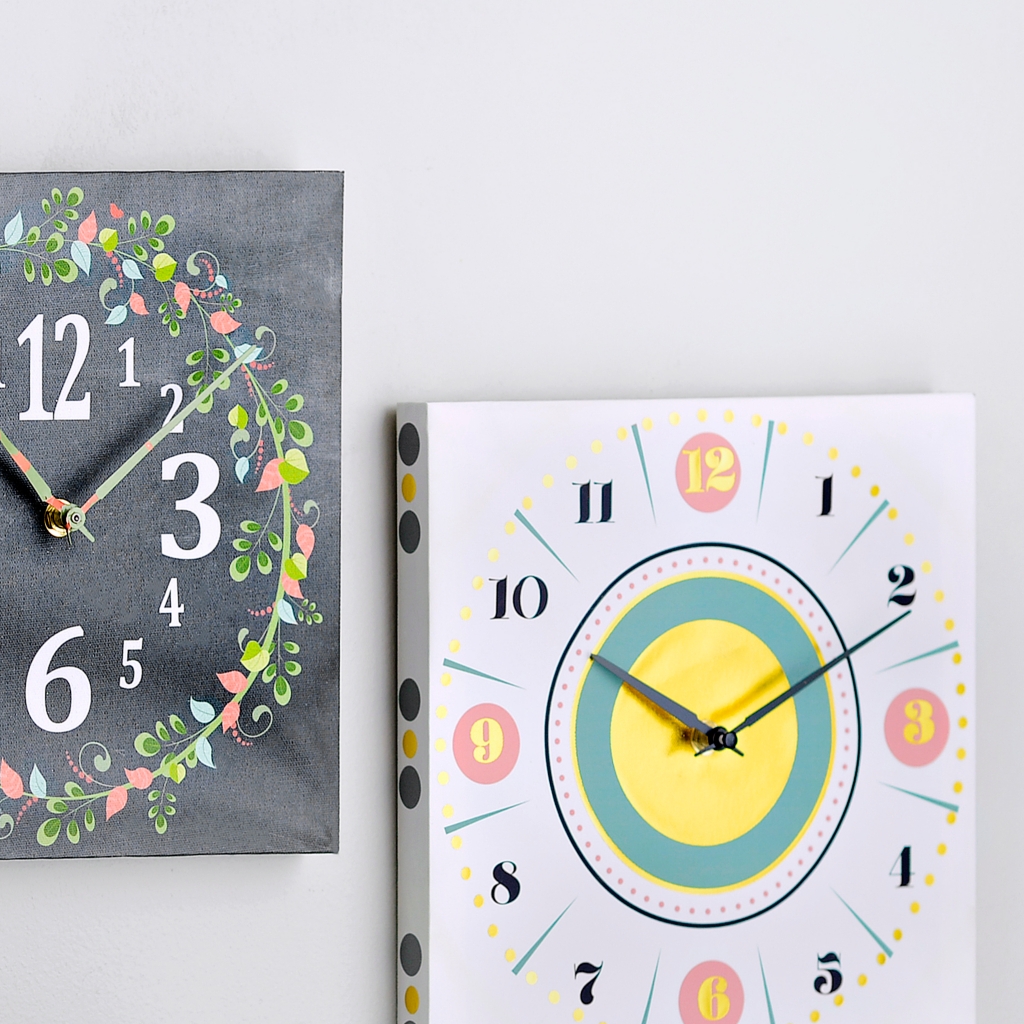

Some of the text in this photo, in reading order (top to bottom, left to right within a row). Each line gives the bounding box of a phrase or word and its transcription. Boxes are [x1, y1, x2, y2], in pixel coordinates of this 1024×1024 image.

[17, 314, 91, 420] 12
[118, 337, 141, 388] 1
[160, 383, 184, 434] 2
[681, 446, 737, 494] 12
[161, 453, 221, 560] 3
[572, 479, 614, 524] 11
[816, 474, 834, 517] 1
[160, 578, 184, 627] 4
[489, 575, 549, 620] 10
[887, 564, 917, 608] 2
[26, 626, 92, 732] 6
[120, 638, 143, 690] 5
[469, 717, 505, 765] 9
[903, 698, 936, 746] 3
[490, 861, 521, 905] 8
[889, 845, 915, 889] 4
[573, 962, 603, 1006] 7
[813, 952, 844, 995] 5
[697, 976, 731, 1022] 6
